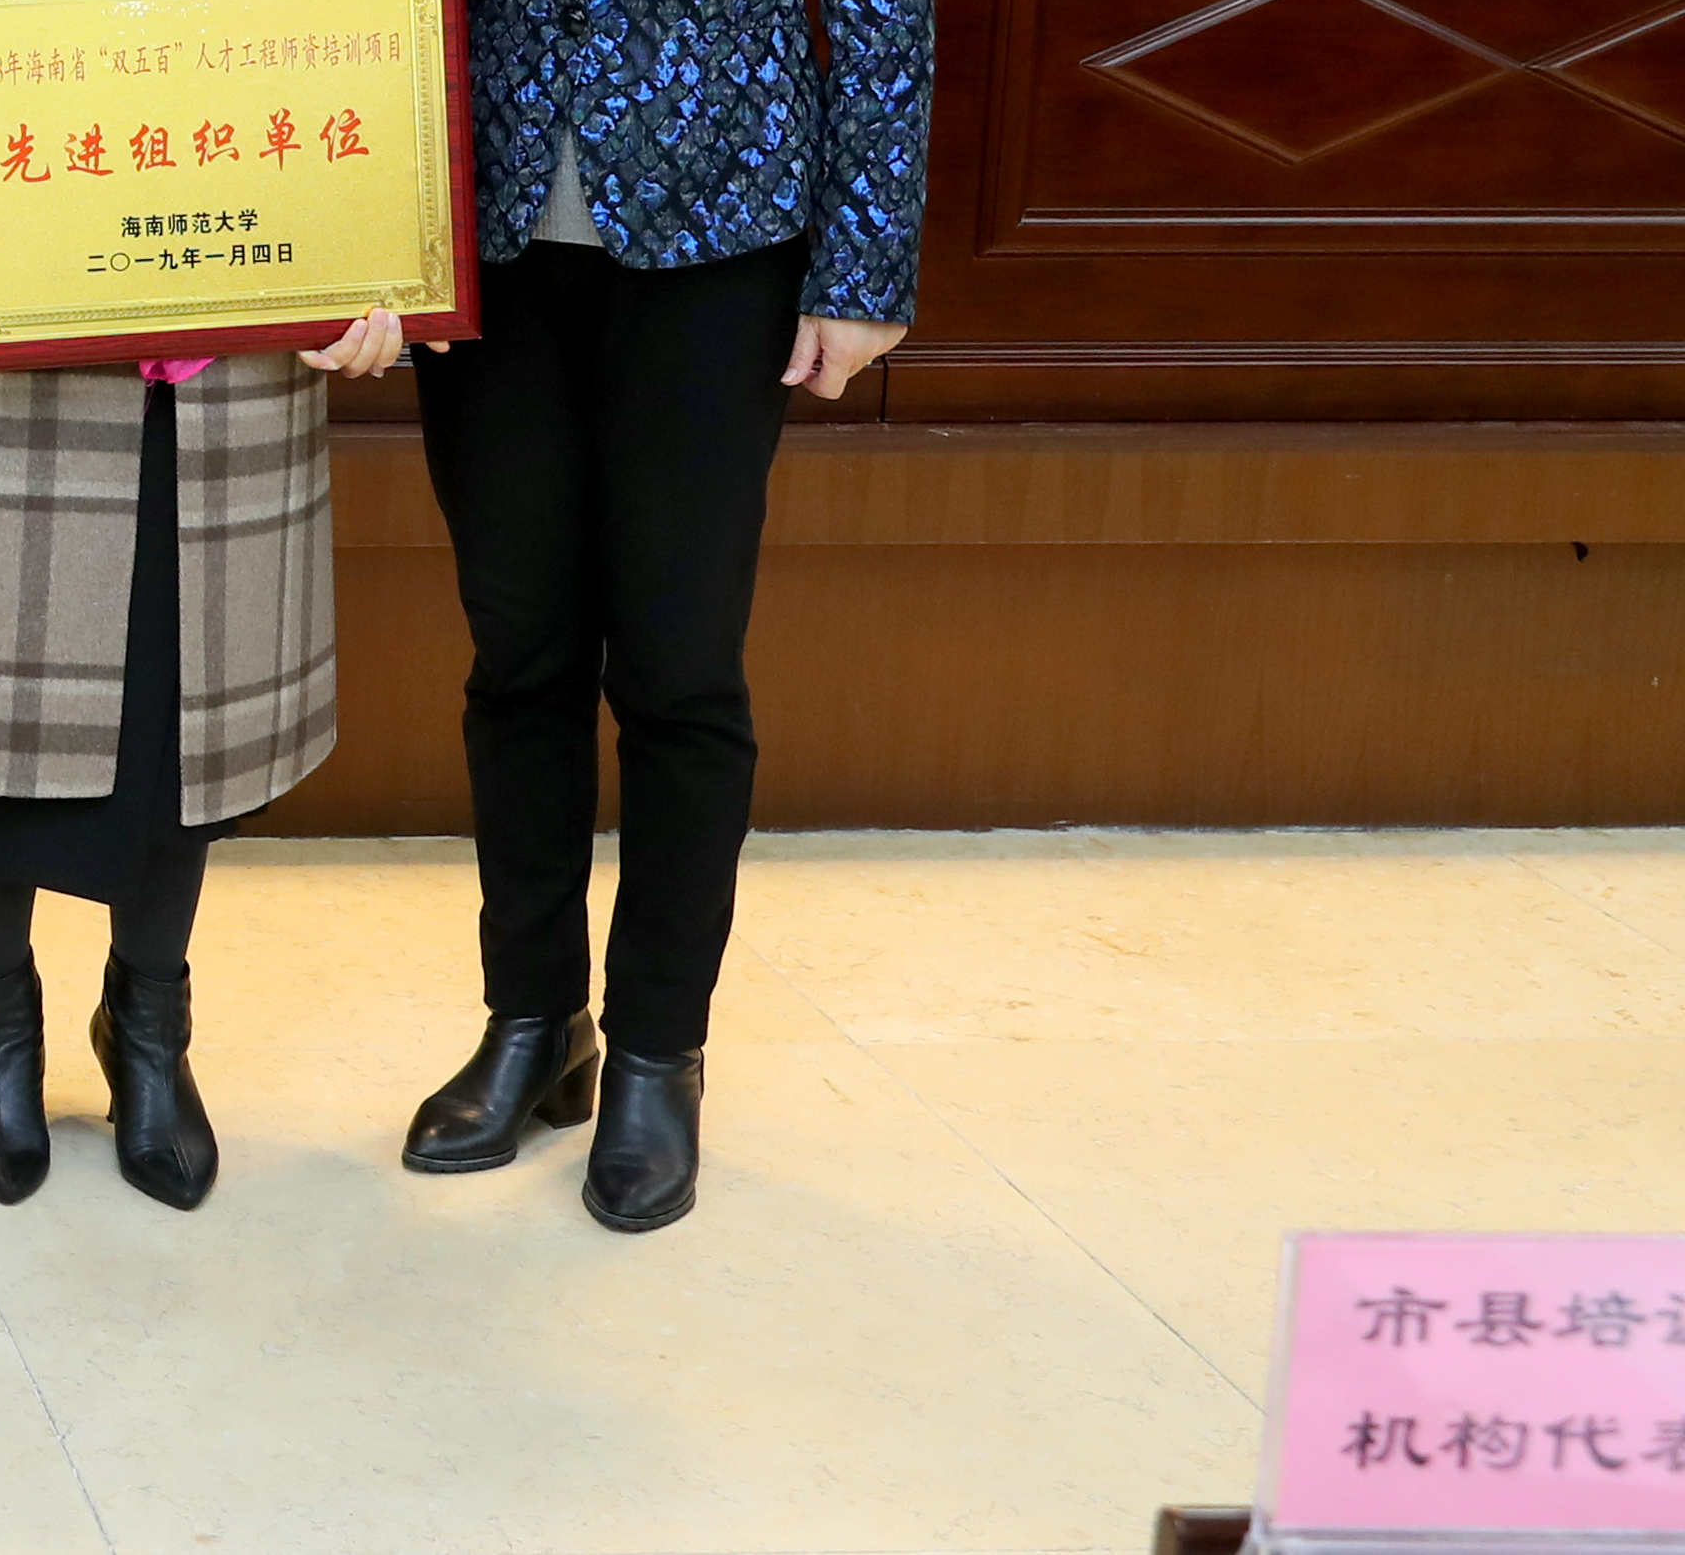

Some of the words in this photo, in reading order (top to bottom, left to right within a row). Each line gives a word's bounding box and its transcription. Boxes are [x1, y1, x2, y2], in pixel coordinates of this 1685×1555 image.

[0, 107, 371, 183] 先进组织单位
[120, 207, 259, 239] 海南师范大学
